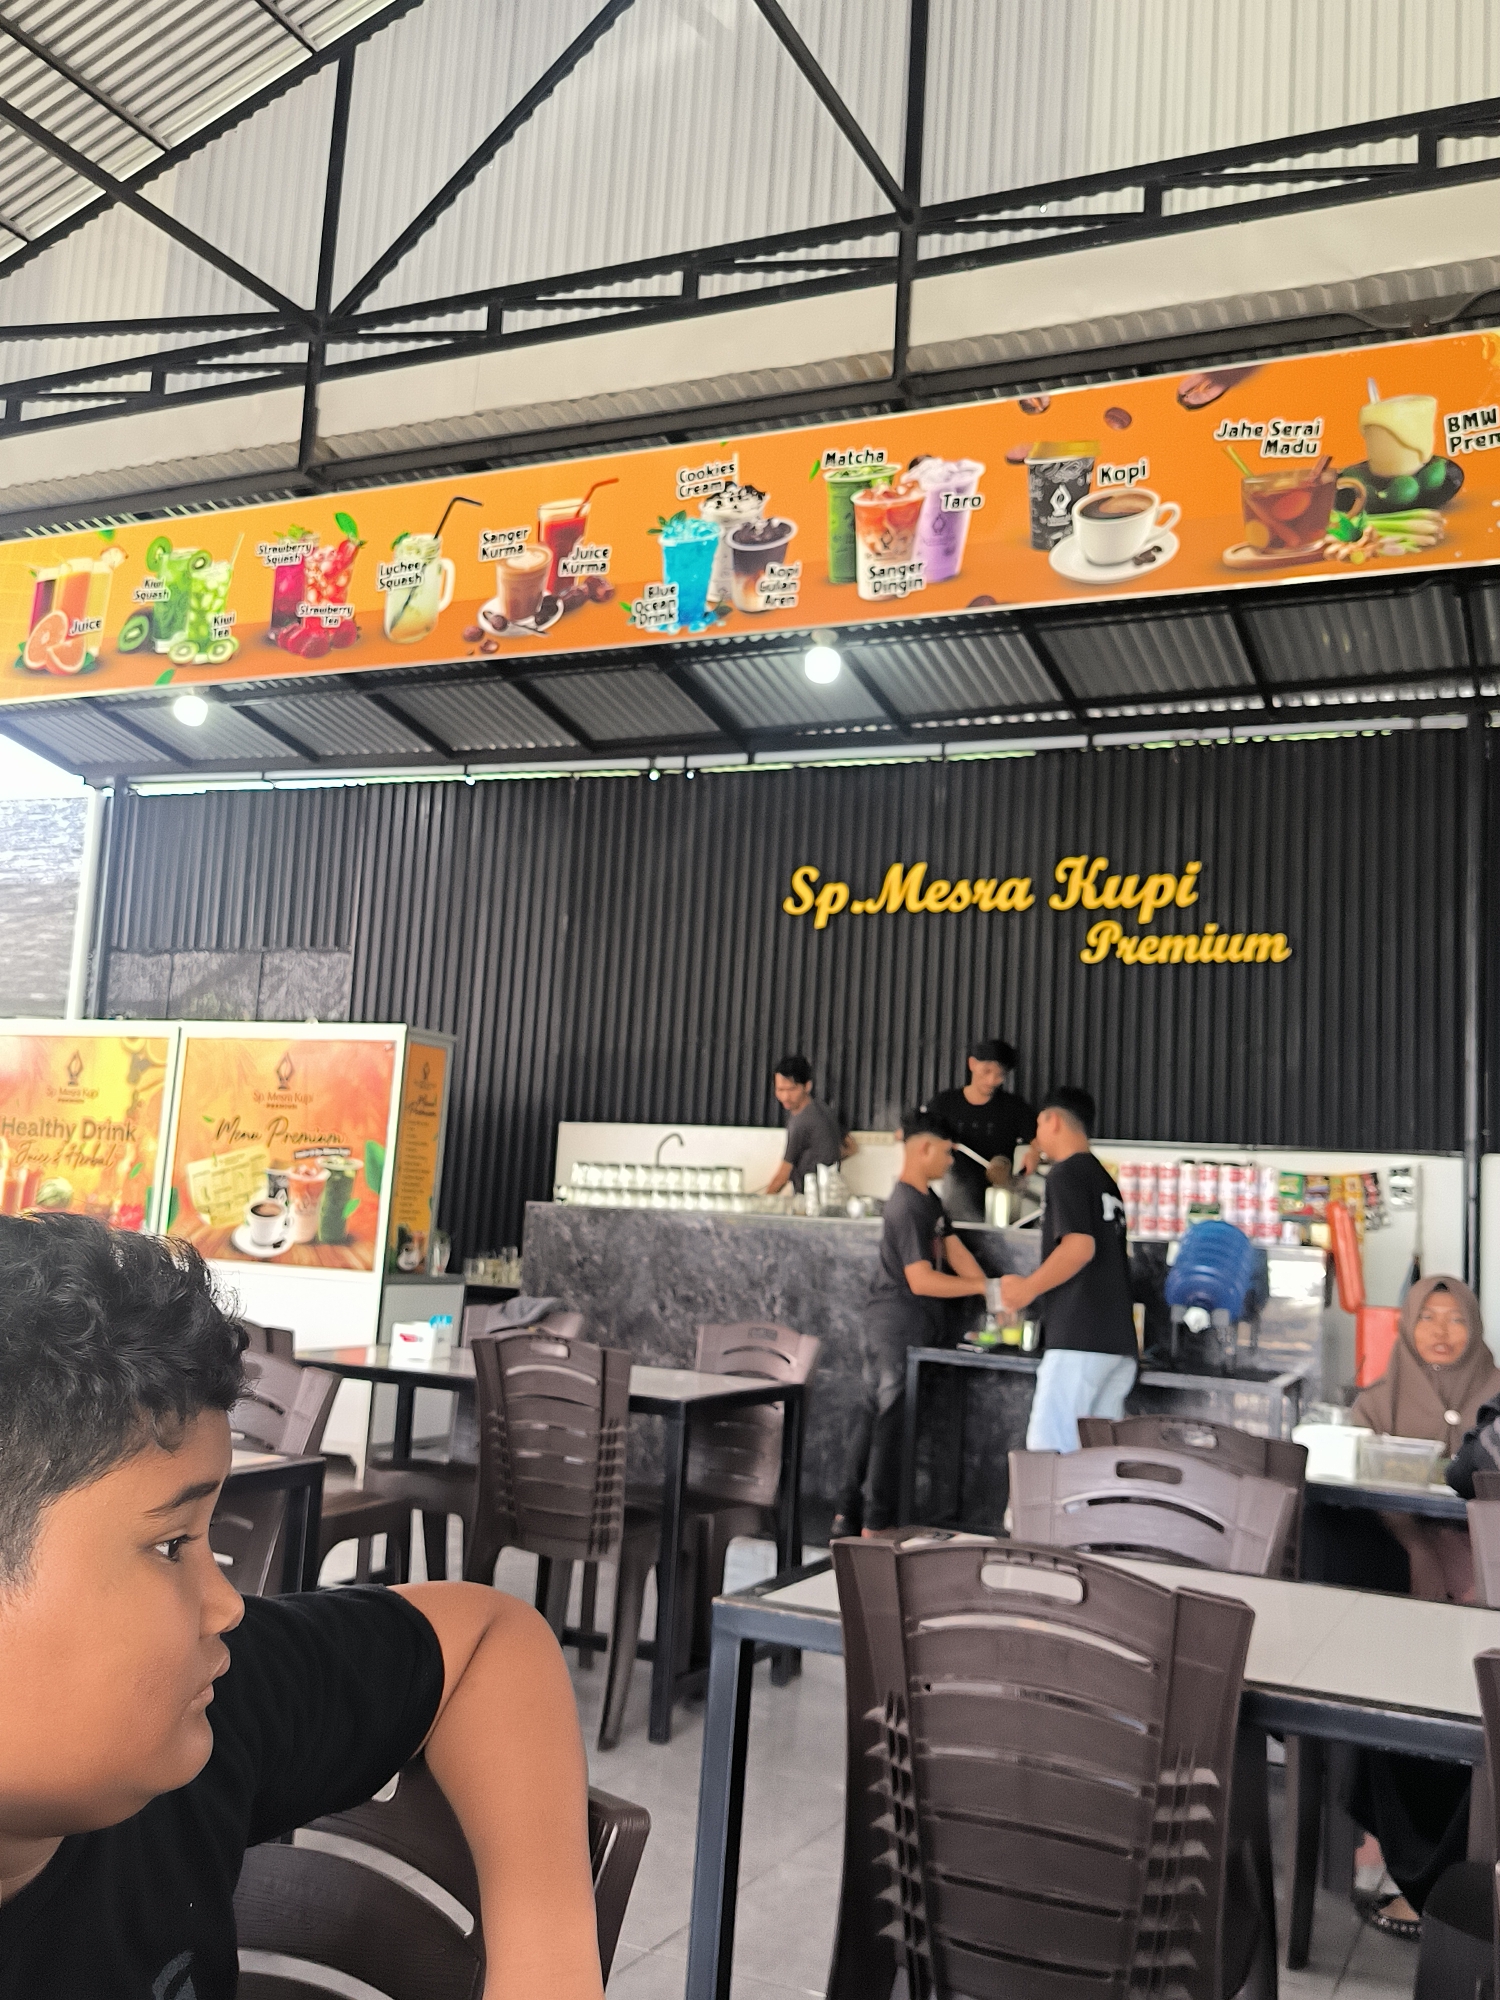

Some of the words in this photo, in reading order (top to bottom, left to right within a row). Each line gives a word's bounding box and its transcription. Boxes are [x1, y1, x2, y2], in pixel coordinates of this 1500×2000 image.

[1217, 421, 1263, 438] Jahe
[1271, 419, 1321, 437] Serai
[1447, 408, 1497, 433] BMW
[1264, 438, 1317, 455] Madu
[825, 450, 885, 466] Matcha
[679, 462, 735, 483] Cookies
[1100, 460, 1147, 484] Kopi
[679, 480, 723, 498] Cream
[943, 493, 982, 509] Taro
[482, 527, 530, 546] Sanger
[258, 543, 312, 555] Strawberry
[481, 544, 524, 560] Kurma
[571, 547, 609, 560] Juice
[266, 554, 301, 566] Squash
[561, 561, 607, 575] Kurma
[379, 561, 421, 577] Lychee
[769, 563, 799, 579] Kopi
[869, 561, 924, 580] Sanger
[378, 573, 422, 590] Squash
[873, 576, 924, 595] Dingin
[299, 605, 353, 617] Strawberry
[635, 599, 677, 614] Ocean
[71, 618, 102, 635] Juice
[213, 612, 235, 626] Kiwi
[1048, 854, 1202, 924] Kupi
[1080, 919, 1293, 965] Premium
[1, 1116, 76, 1144] Healthy
[81, 1117, 137, 1142] Drink
[214, 1115, 262, 1147] Menu
[265, 1116, 348, 1149] Premium
